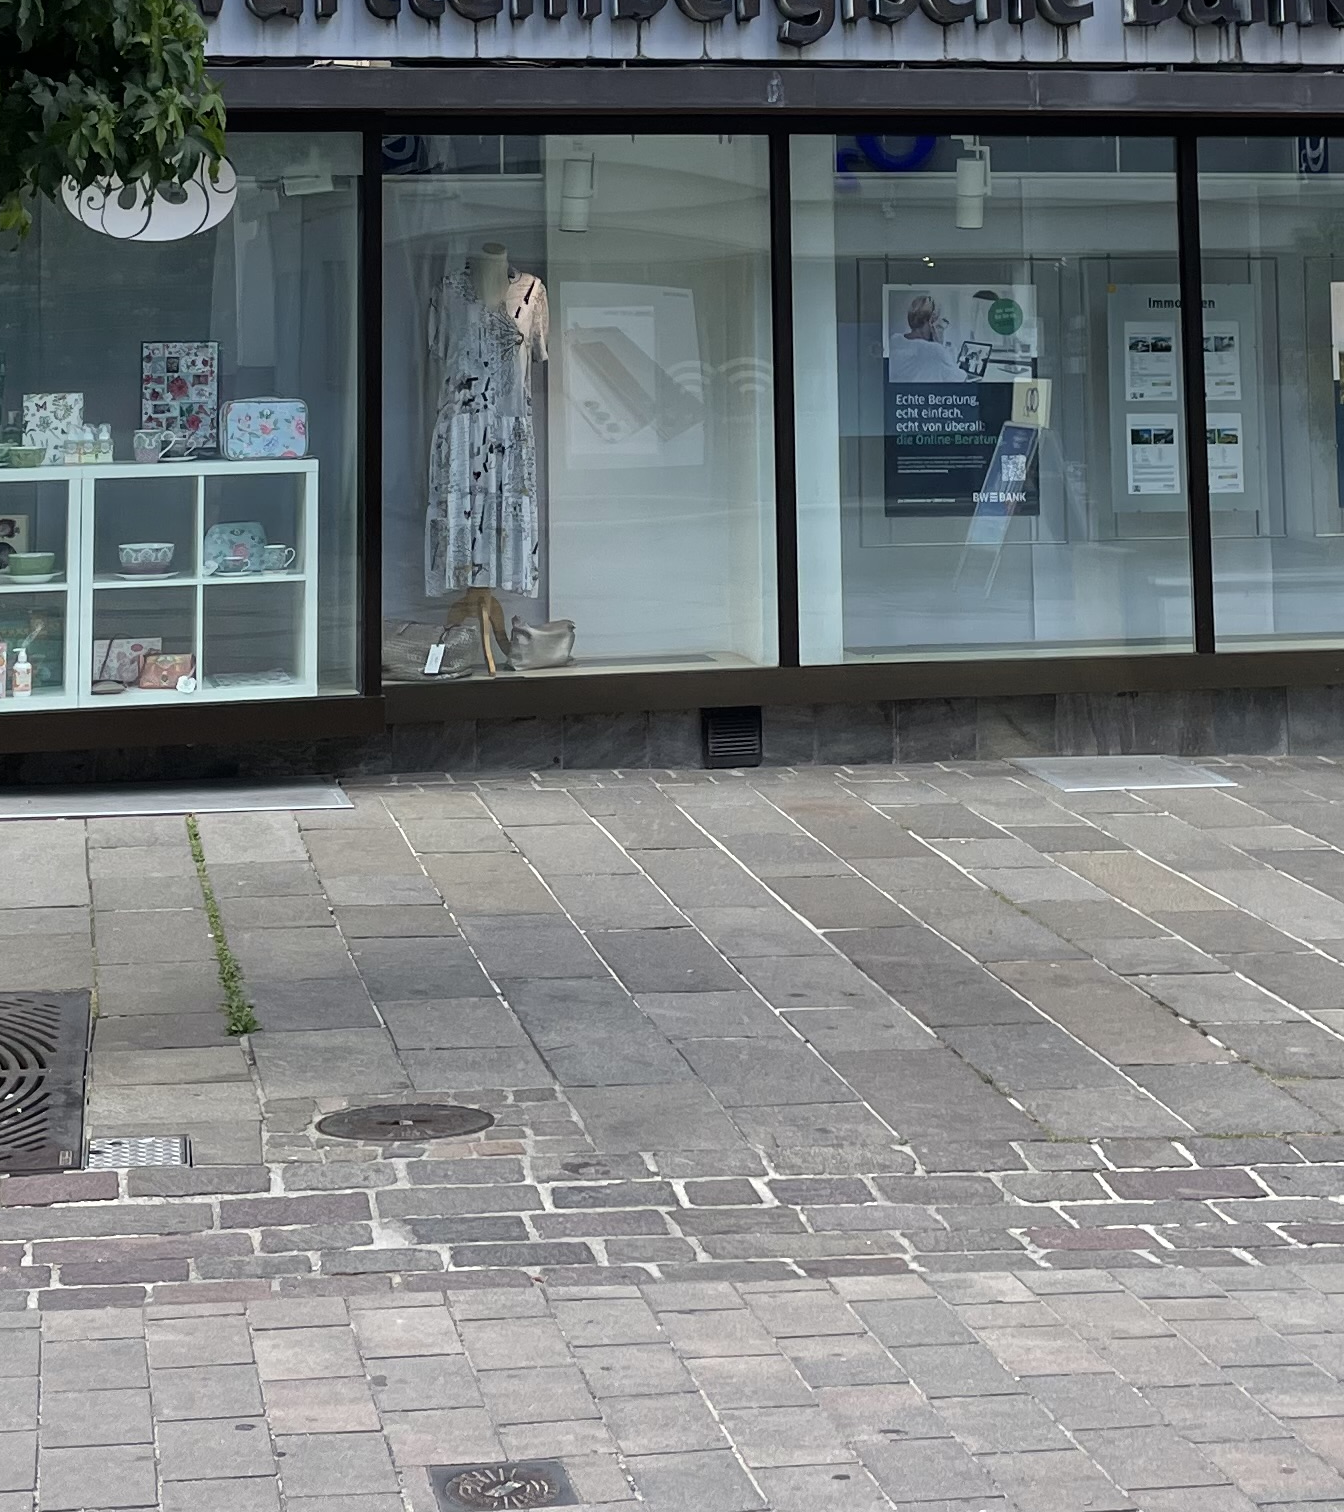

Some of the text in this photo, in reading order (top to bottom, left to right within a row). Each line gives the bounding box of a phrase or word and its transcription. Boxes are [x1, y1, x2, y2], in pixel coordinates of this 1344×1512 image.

[895, 394, 926, 405] Echte
[895, 407, 919, 419] echt
[895, 420, 919, 432] echt
[921, 422, 943, 432] von
[896, 434, 913, 446] die
